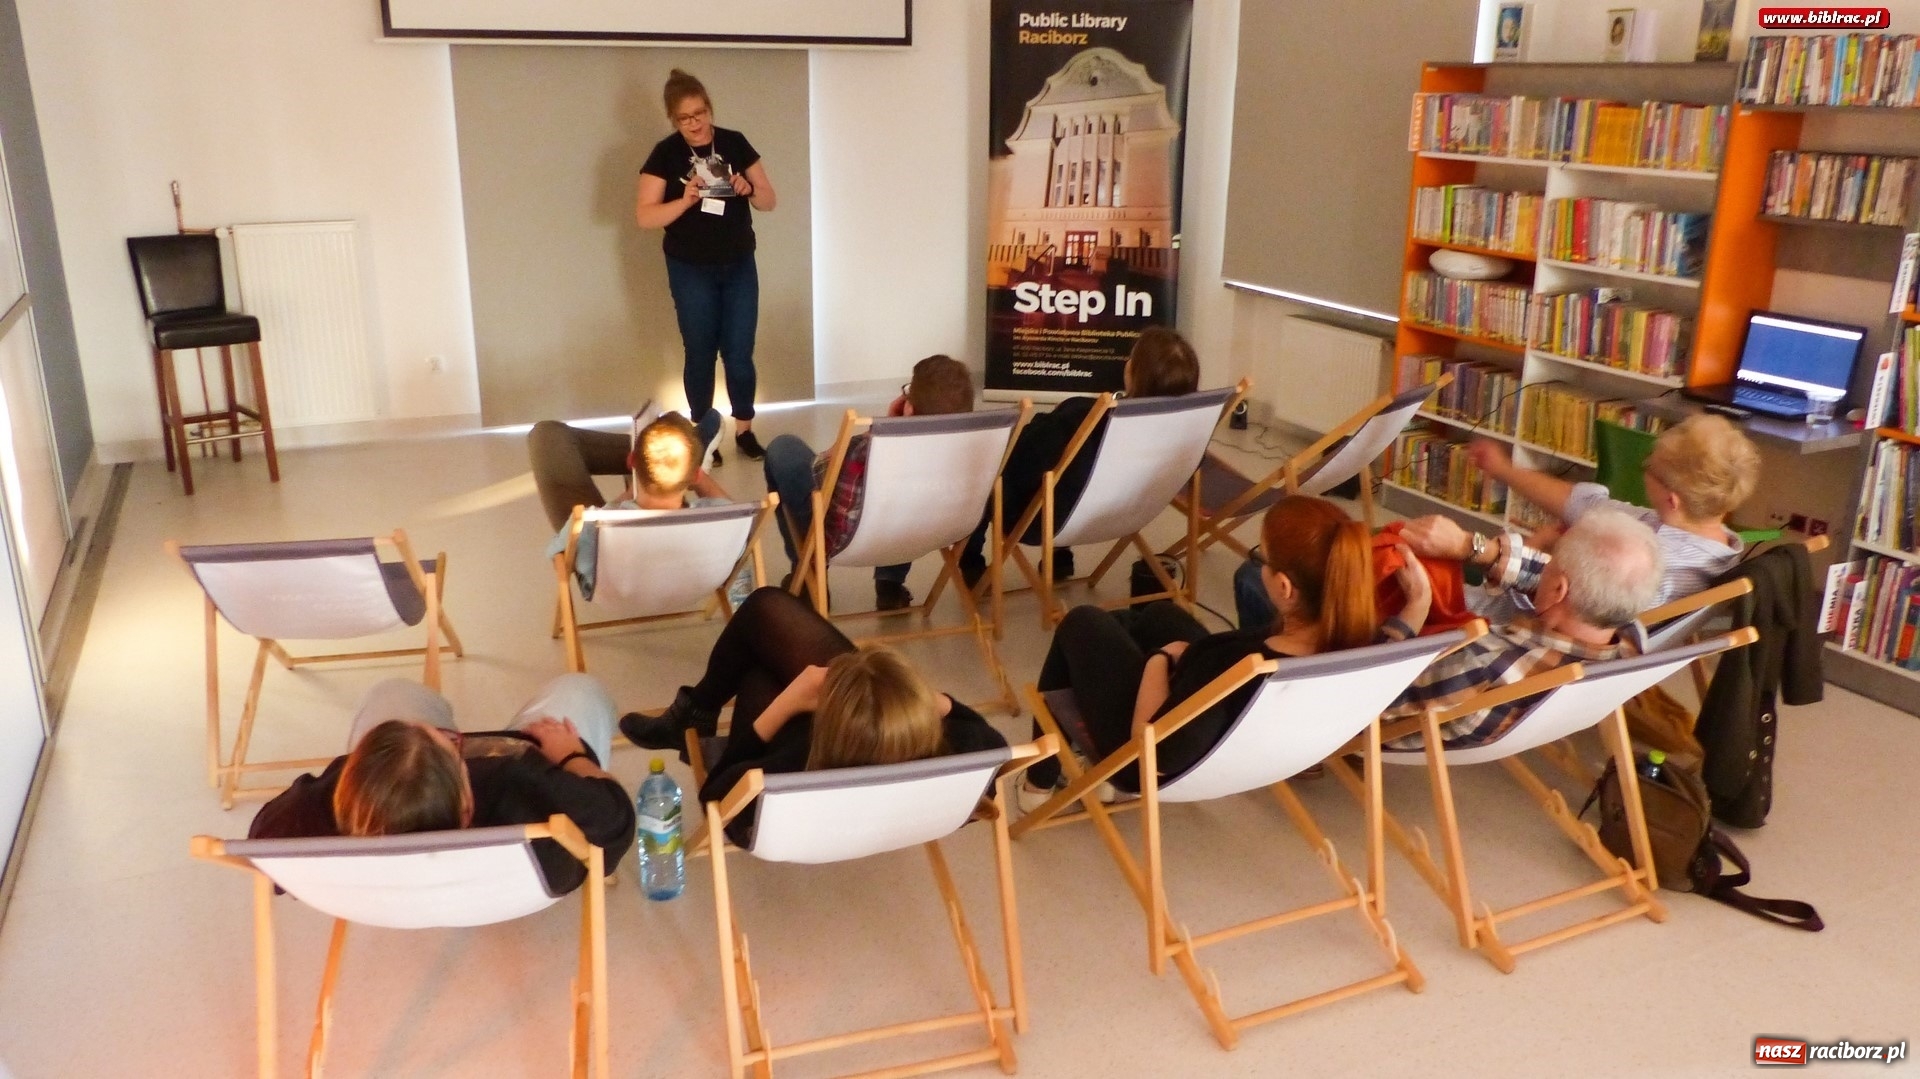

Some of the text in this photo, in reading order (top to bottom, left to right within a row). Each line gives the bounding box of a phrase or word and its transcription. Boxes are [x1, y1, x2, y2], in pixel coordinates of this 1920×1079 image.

[1019, 13, 1128, 32] Public Library
[1019, 30, 1088, 45] Raciborz
[1013, 281, 1153, 323] Step In
[1013, 361, 1070, 370] www.biblrac.pl
[1013, 368, 1093, 378] facebook.com/biblrac
